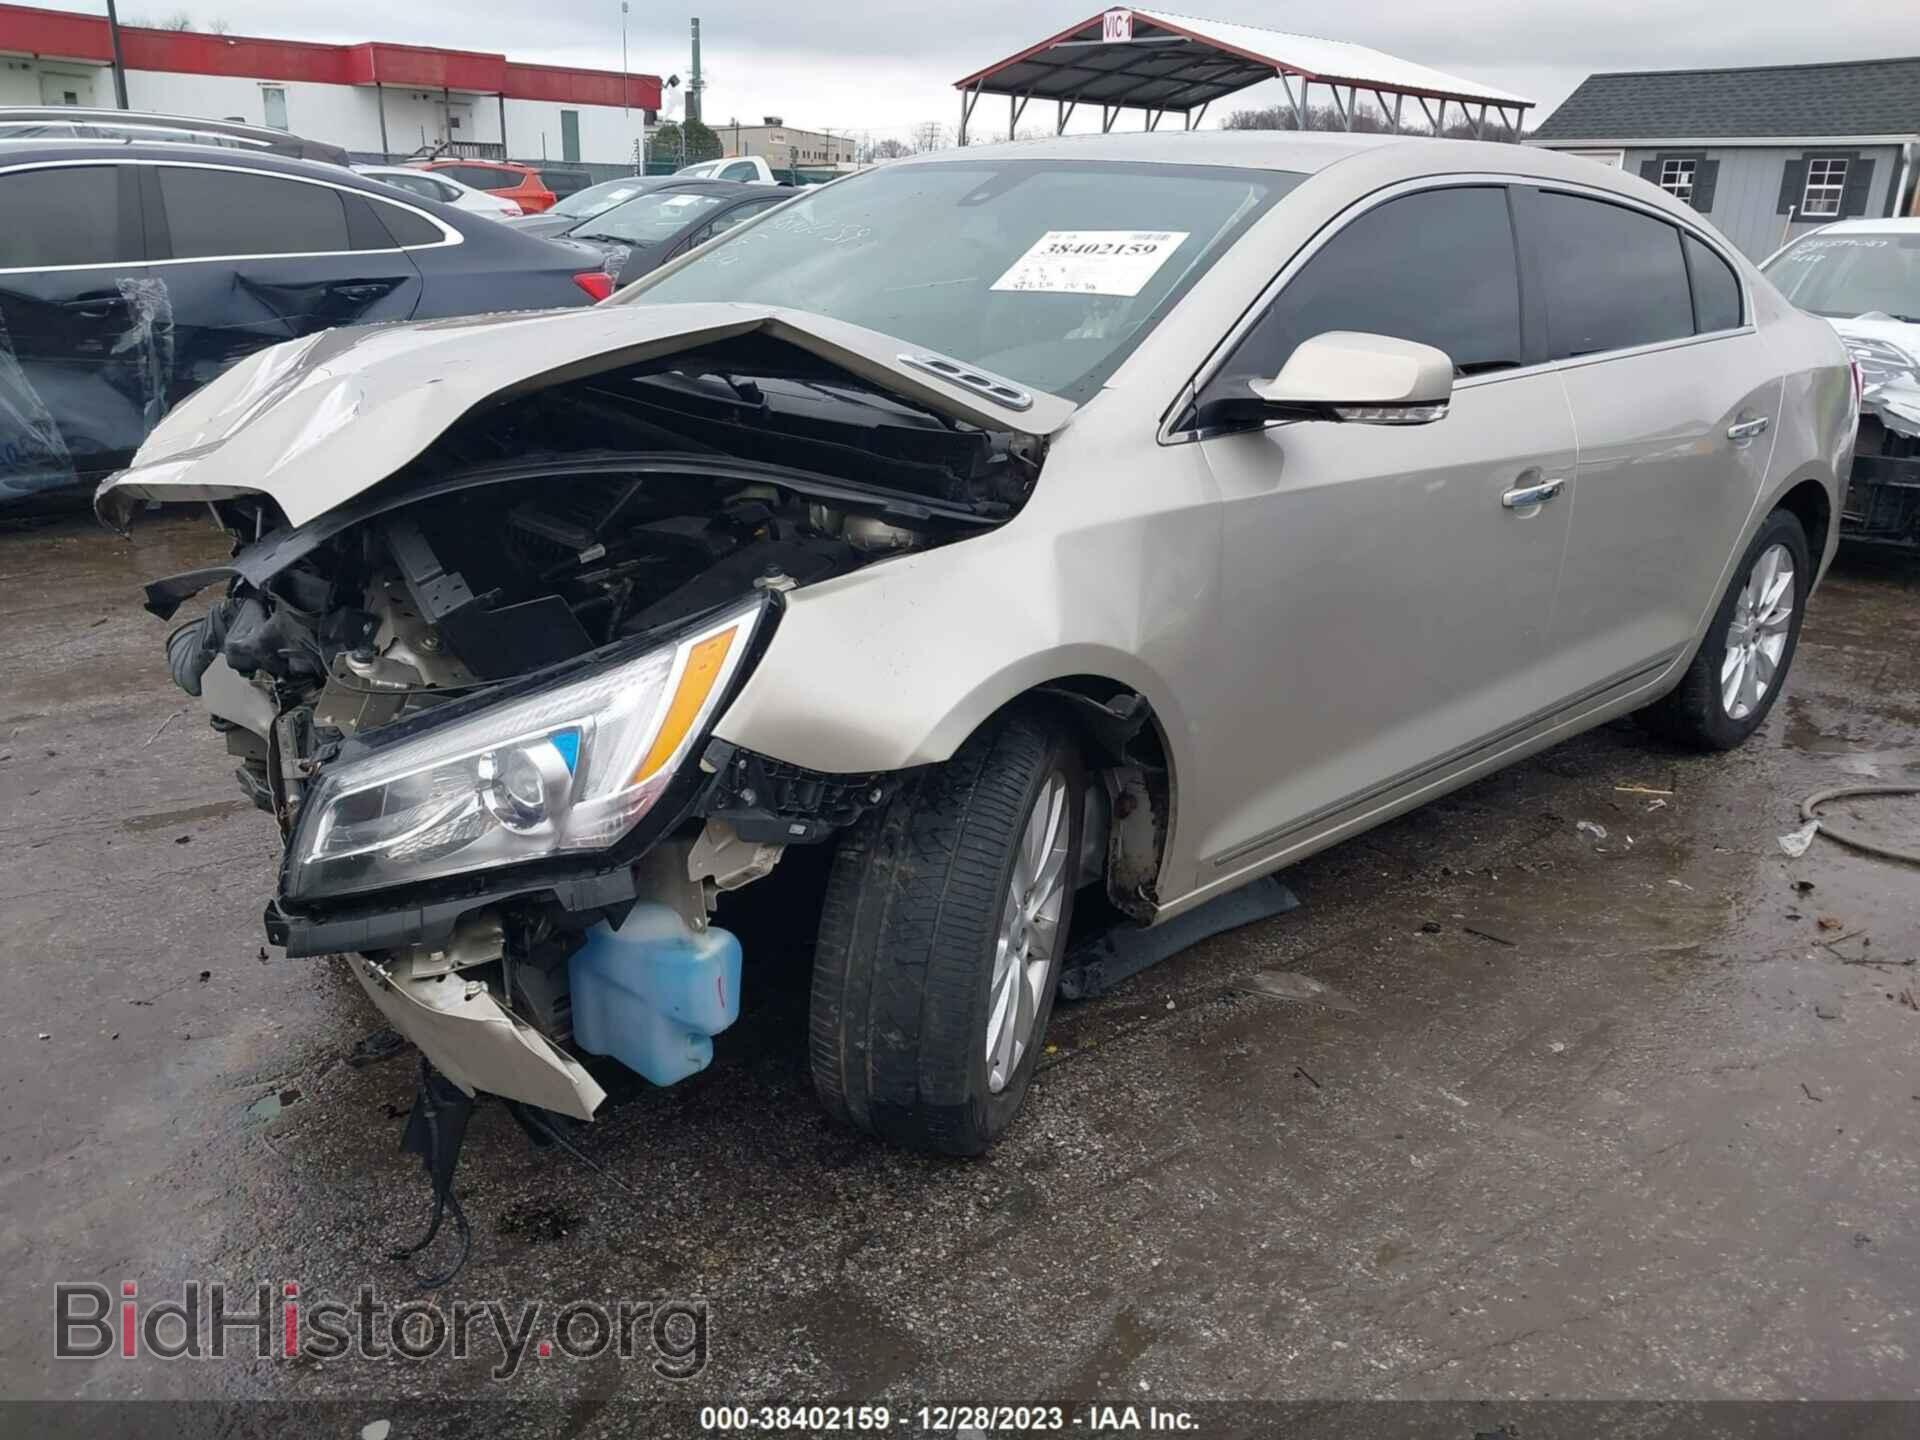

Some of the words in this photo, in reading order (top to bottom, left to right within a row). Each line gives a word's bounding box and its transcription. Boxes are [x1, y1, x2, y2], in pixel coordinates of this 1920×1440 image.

[1104, 15, 1121, 37] VIC
[1125, 14, 1133, 36] 1
[1040, 243, 1157, 255] 38402159
